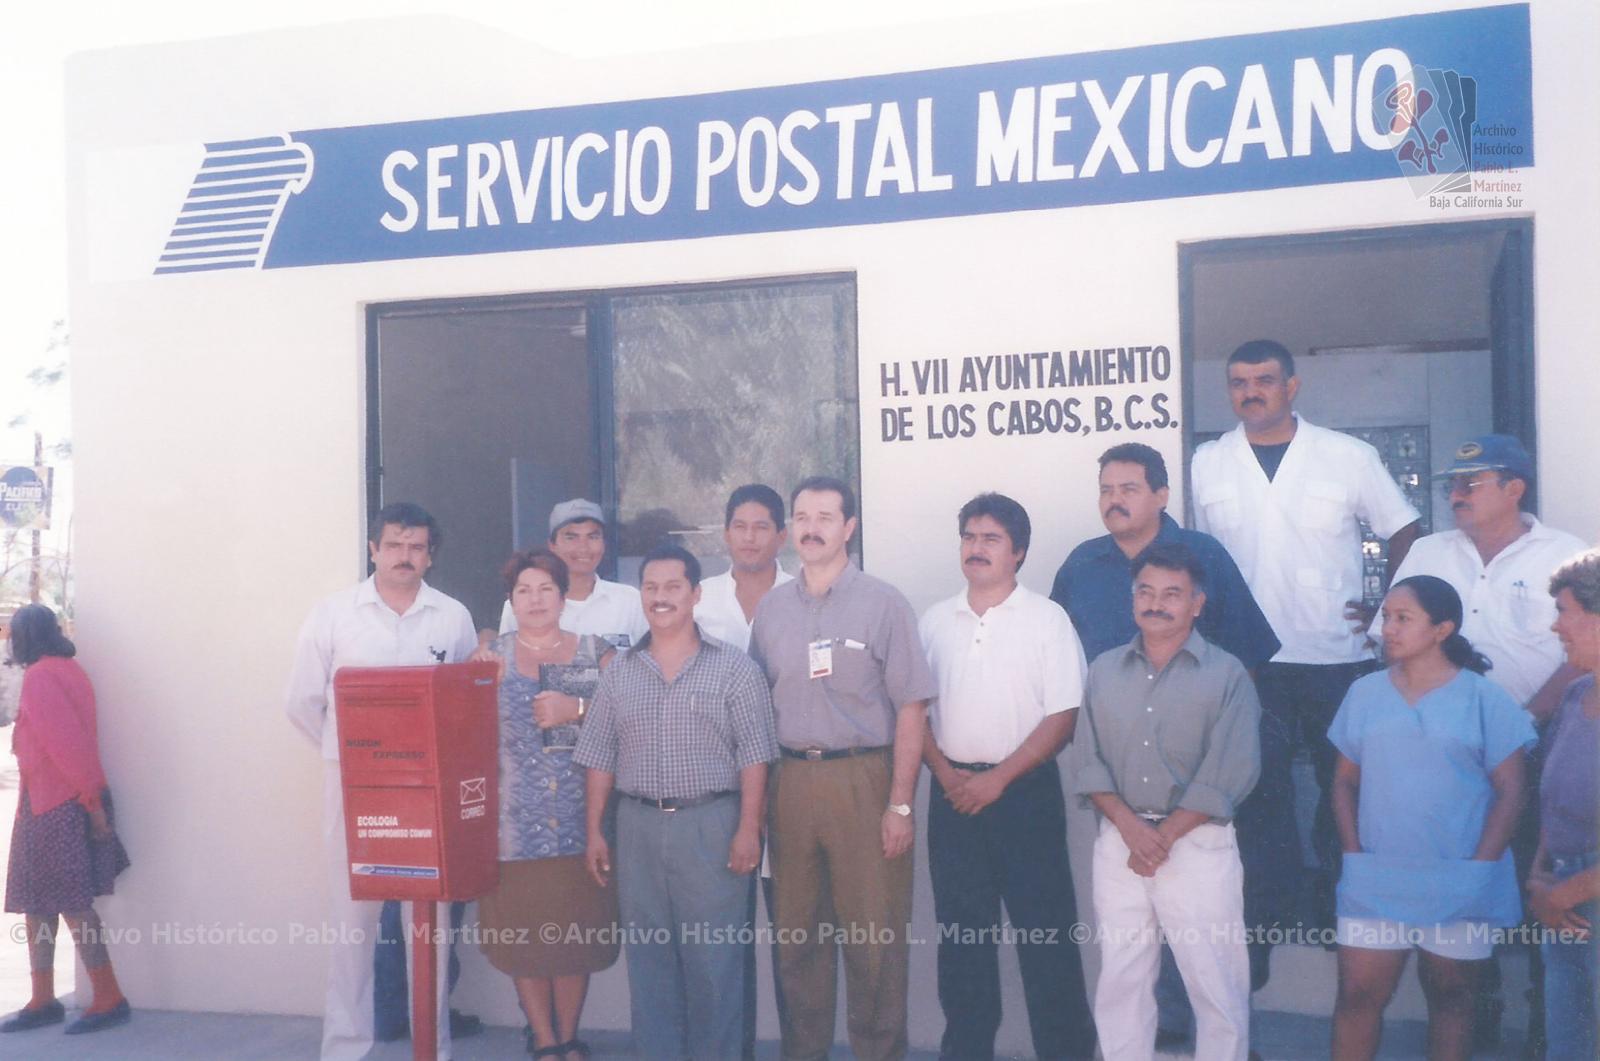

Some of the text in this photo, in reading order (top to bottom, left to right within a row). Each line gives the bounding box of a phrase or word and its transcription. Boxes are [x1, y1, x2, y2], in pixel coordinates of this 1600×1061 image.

[379, 47, 1415, 233] SERVICIO POSTAL MEXICANO
[959, 345, 1172, 393] AYUNTAMIENTO
[881, 406, 914, 442] DE
[926, 403, 977, 440] LOS
